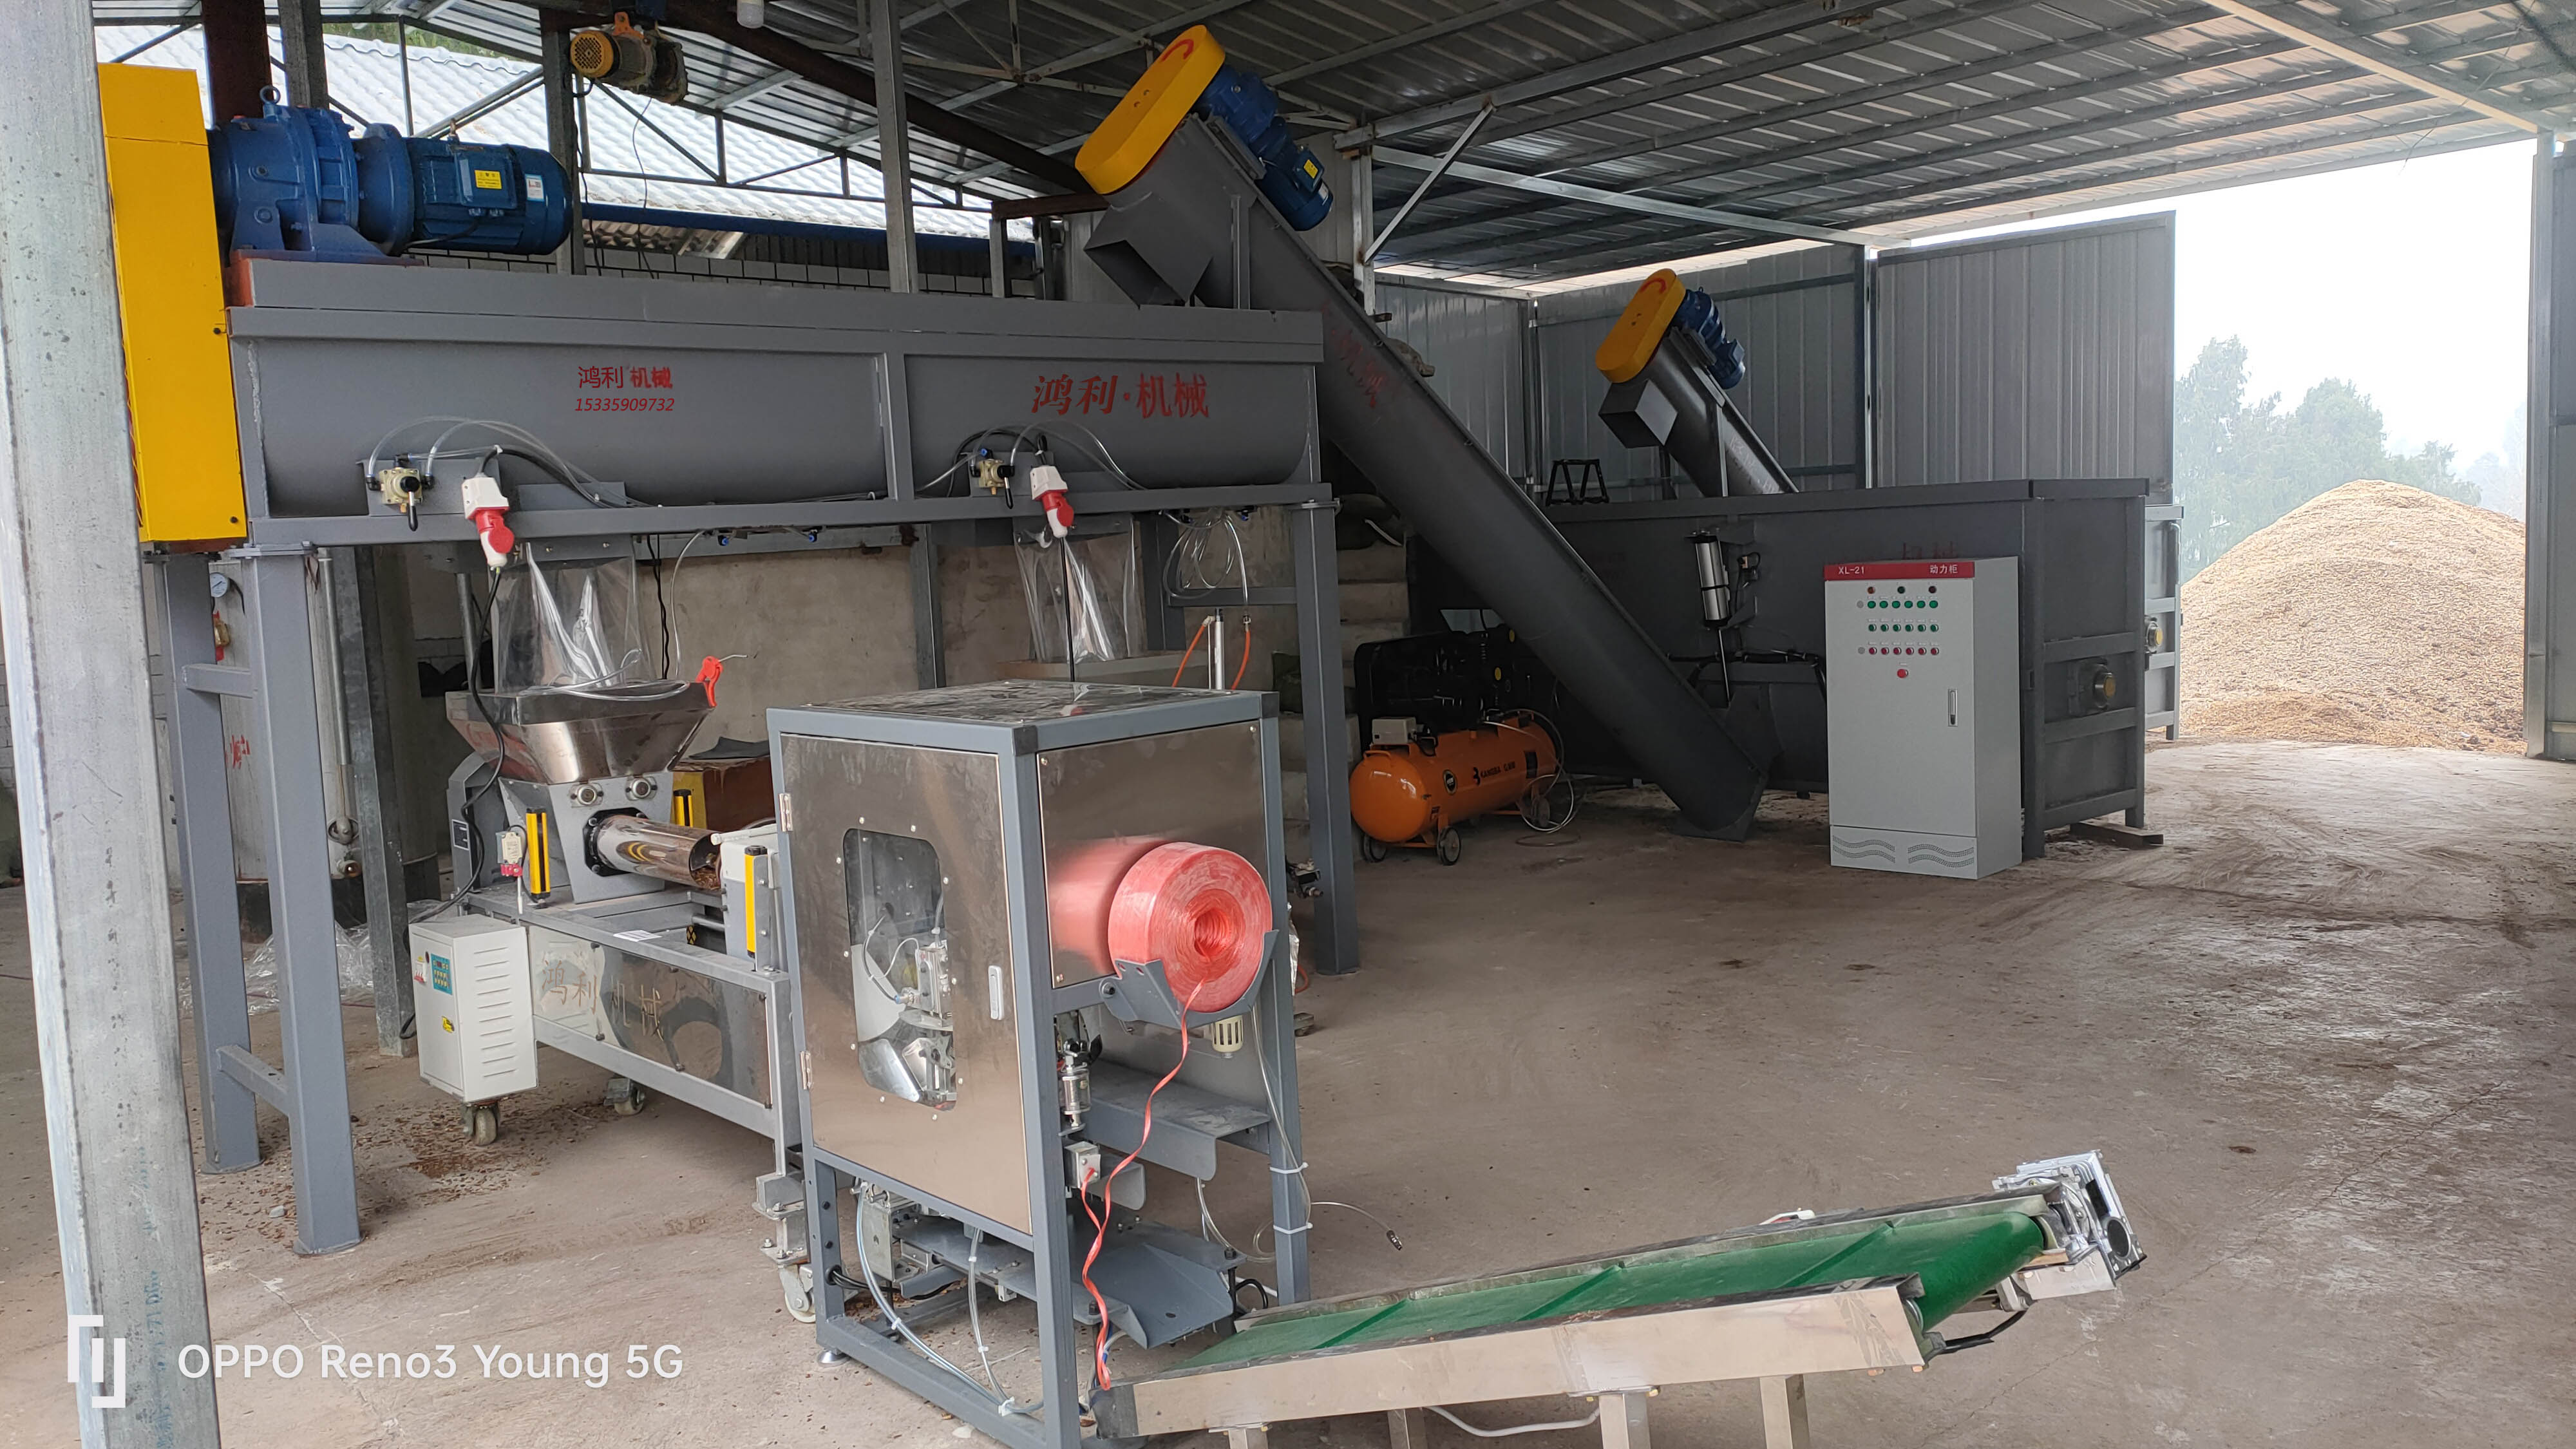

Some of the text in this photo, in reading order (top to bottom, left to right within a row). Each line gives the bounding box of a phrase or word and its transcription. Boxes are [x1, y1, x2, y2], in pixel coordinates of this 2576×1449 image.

[574, 397, 675, 412] 15335909732
[1838, 564, 1958, 575] XL-21 动力柜
